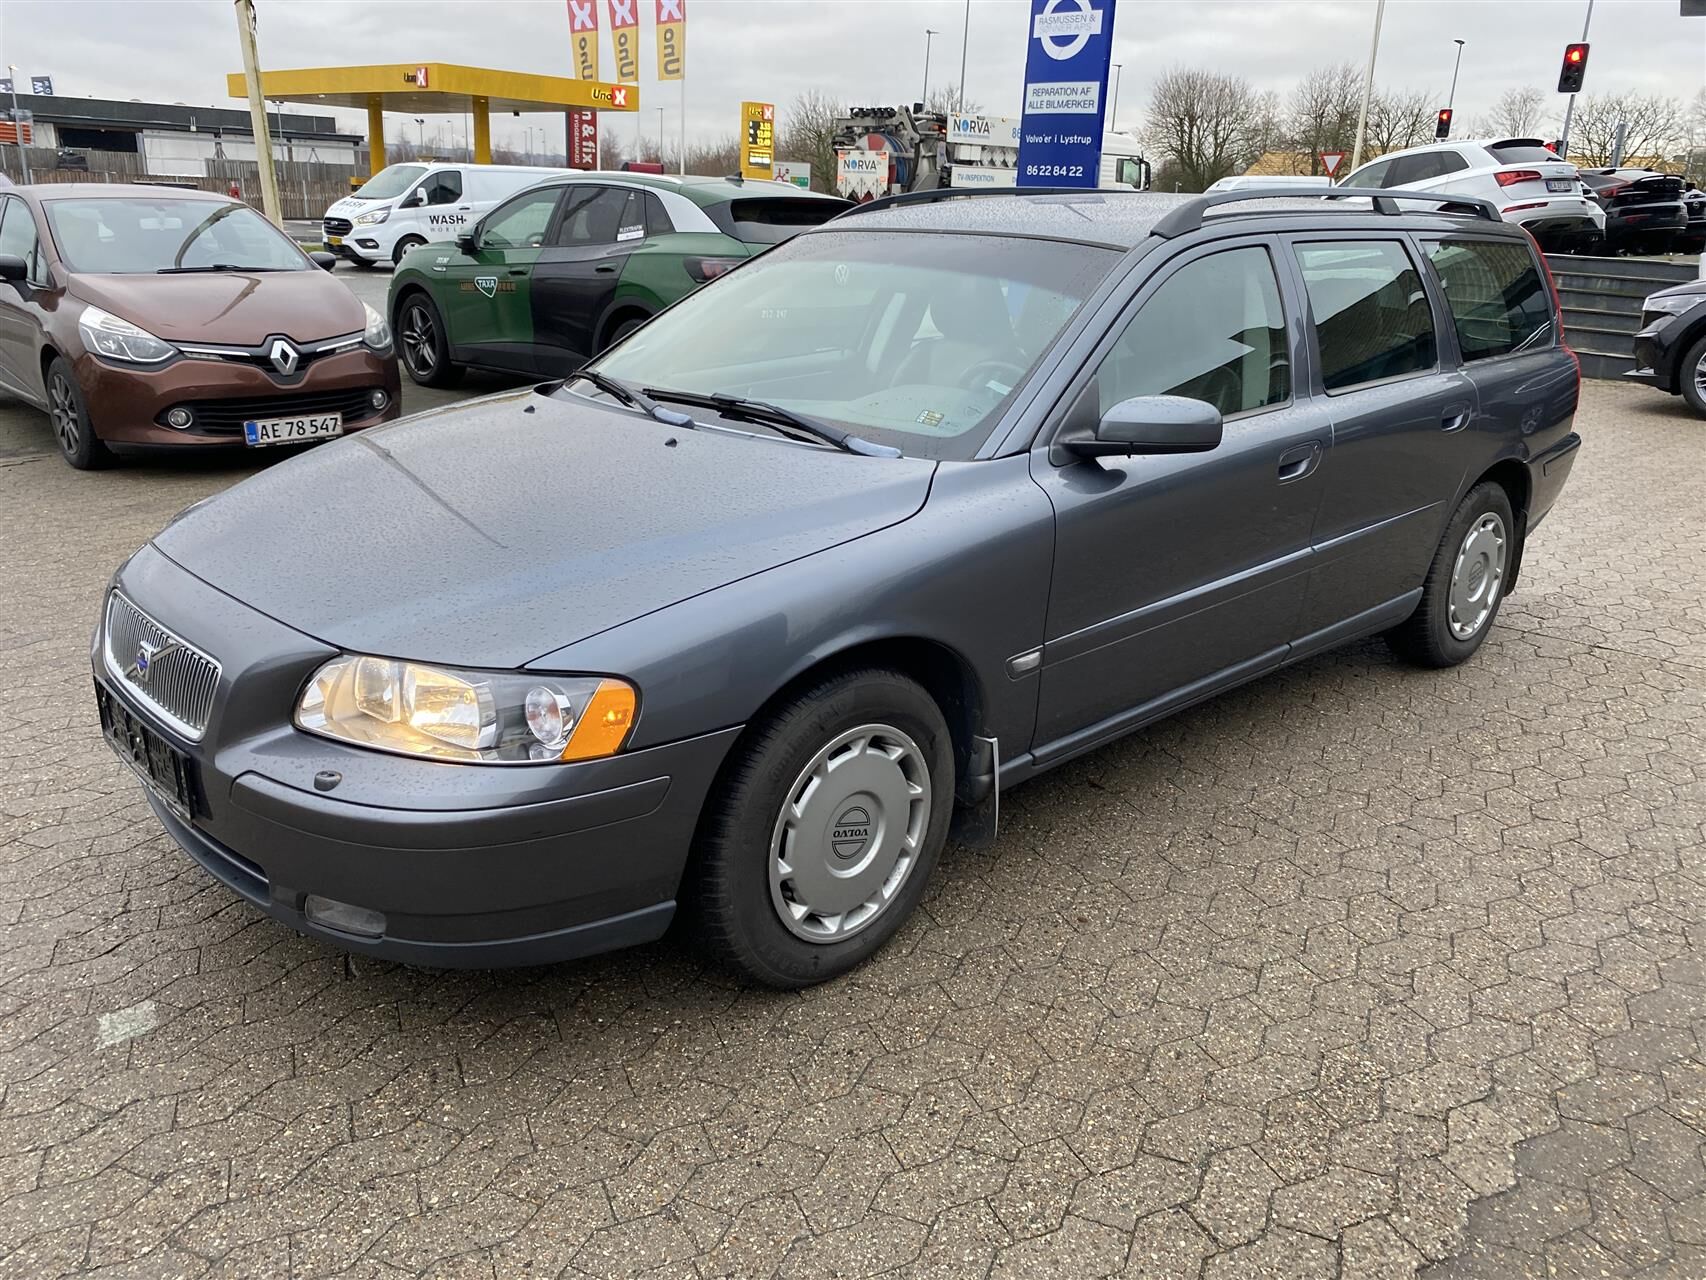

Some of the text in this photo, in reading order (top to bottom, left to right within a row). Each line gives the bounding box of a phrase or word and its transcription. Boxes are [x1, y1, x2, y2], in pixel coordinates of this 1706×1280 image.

[1039, 14, 1087, 25] RASMUSSEN
[1032, 87, 1092, 96] REPARATION AF
[1028, 100, 1095, 109] ALLE BILMÆRKER
[1060, 134, 1092, 145] Lystrup
[582, 141, 596, 164] fix
[1026, 165, 1083, 177] 86 22 84 22
[429, 215, 464, 225] WASH
[478, 280, 495, 288] TAXA
[260, 417, 338, 440] AE 78 547
[833, 828, 868, 838] VOLVO
